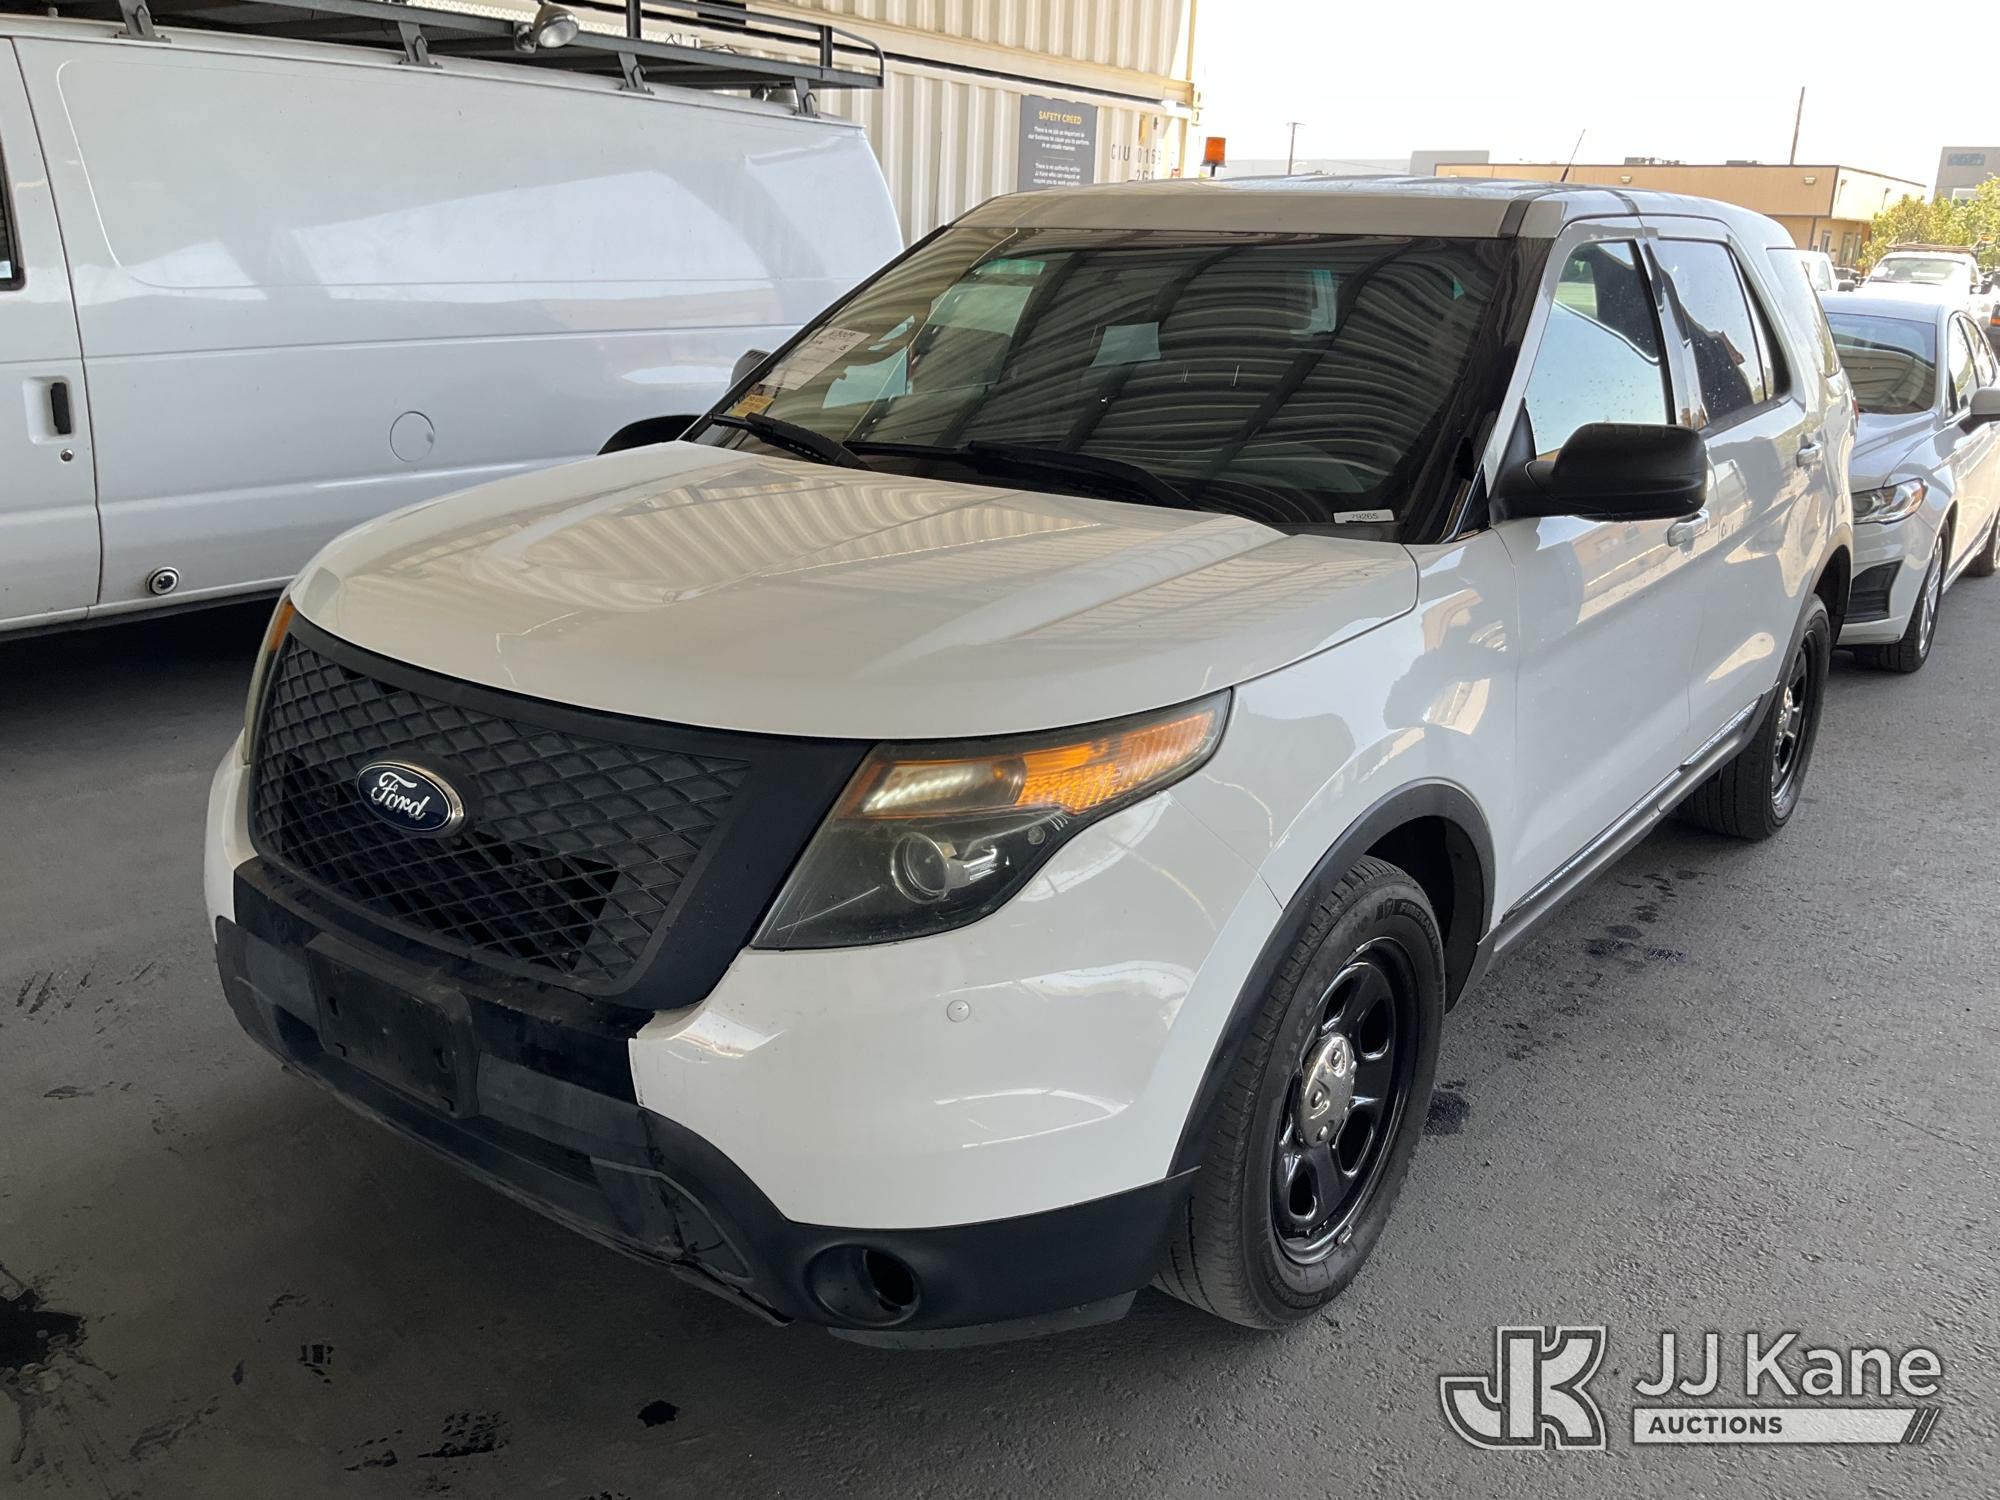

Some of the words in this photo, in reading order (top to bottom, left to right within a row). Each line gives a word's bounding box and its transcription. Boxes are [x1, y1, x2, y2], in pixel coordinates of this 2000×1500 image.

[1038, 110, 1062, 122] SAFETY
[1061, 113, 1082, 125] CREED
[371, 771, 431, 821] Ford
